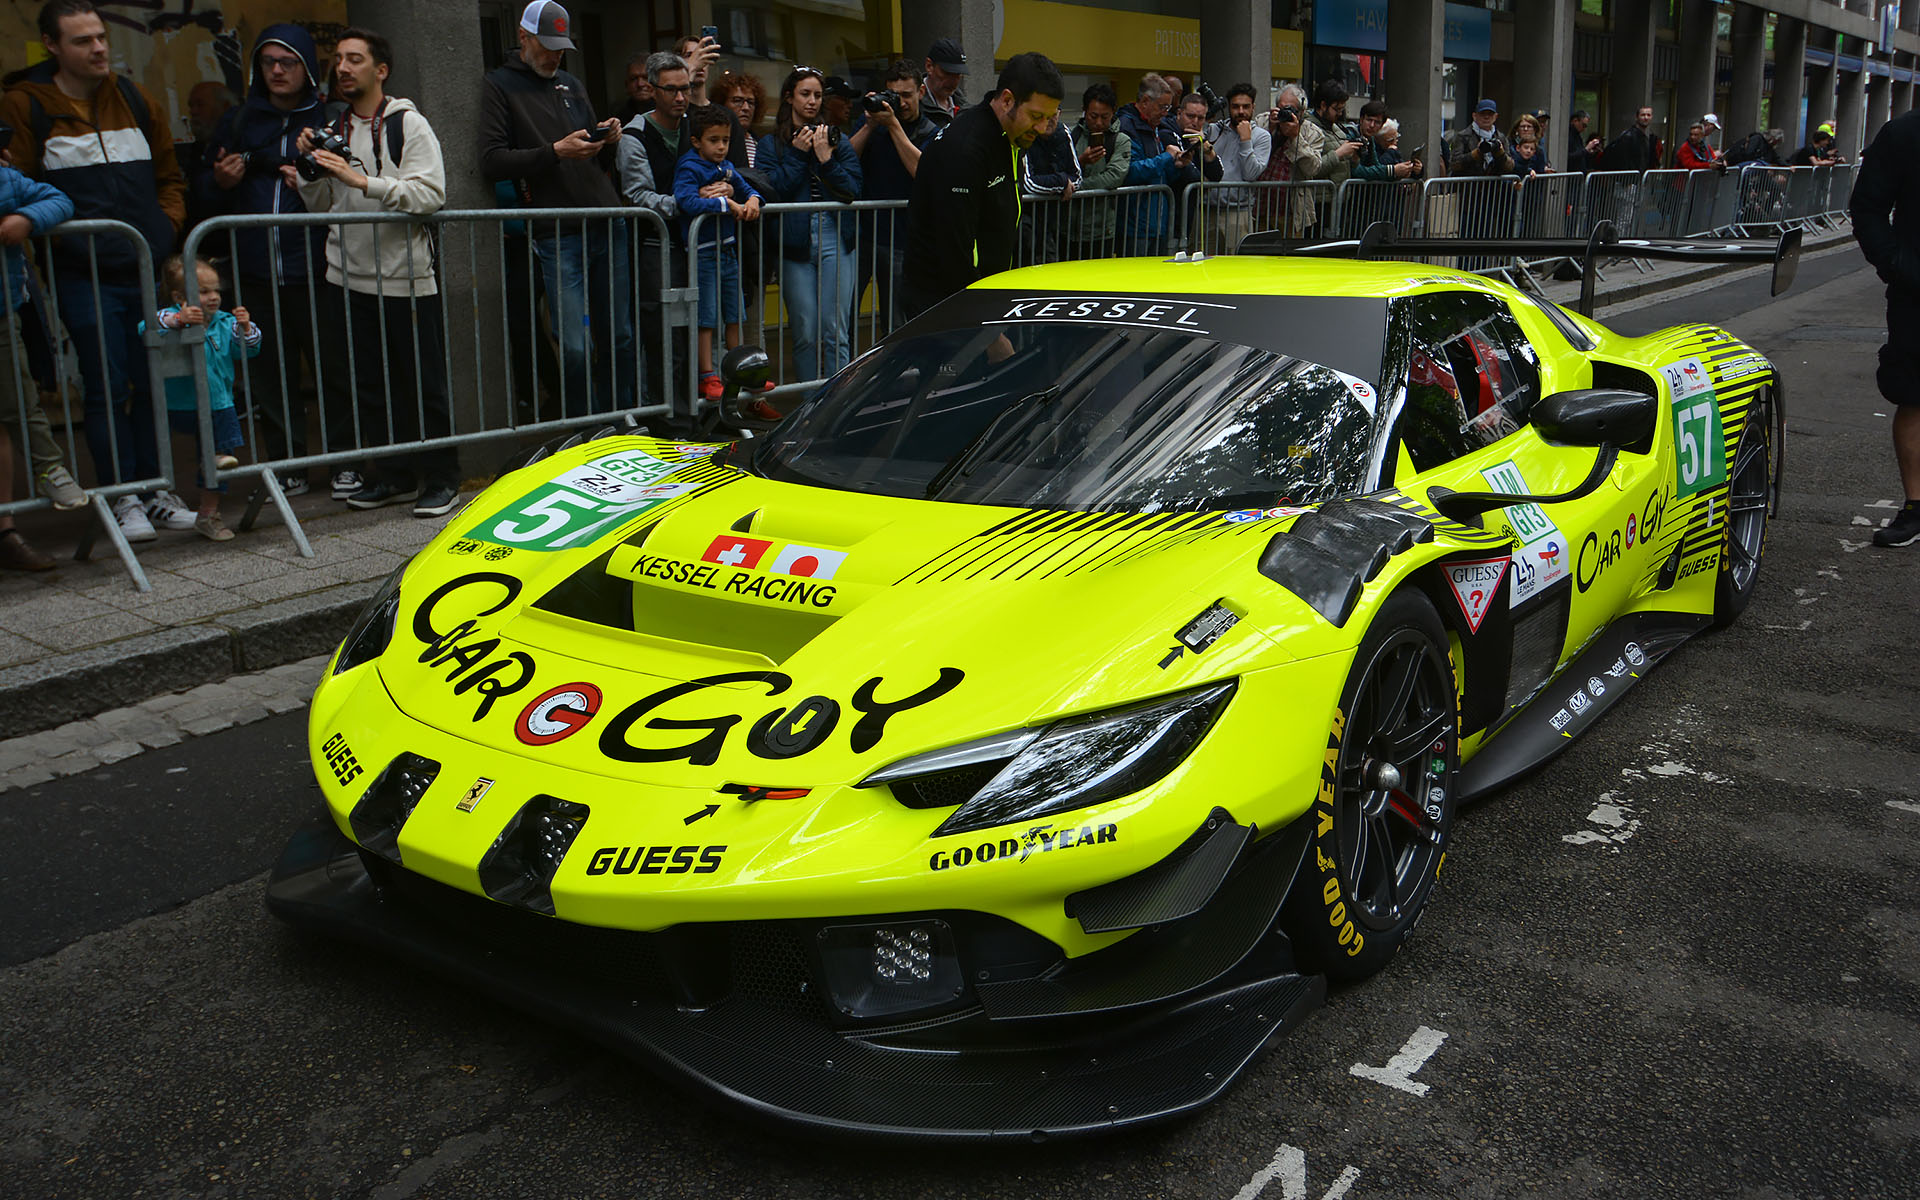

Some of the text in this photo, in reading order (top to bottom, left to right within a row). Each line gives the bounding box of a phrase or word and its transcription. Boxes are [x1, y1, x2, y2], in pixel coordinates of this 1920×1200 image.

[1003, 302, 1199, 326] KESSEL
[1678, 402, 1712, 485] 57
[600, 459, 659, 483] GT3
[493, 490, 654, 547] 57
[1510, 503, 1547, 536] GT3
[630, 554, 837, 608] KESSEL RACING
[1453, 565, 1500, 583] GUESS
[1577, 529, 1621, 594] CAR
[1678, 553, 1718, 581] GUESS
[413, 572, 536, 722] CAR
[322, 732, 364, 787] GUESS
[586, 845, 728, 876] GUESS
